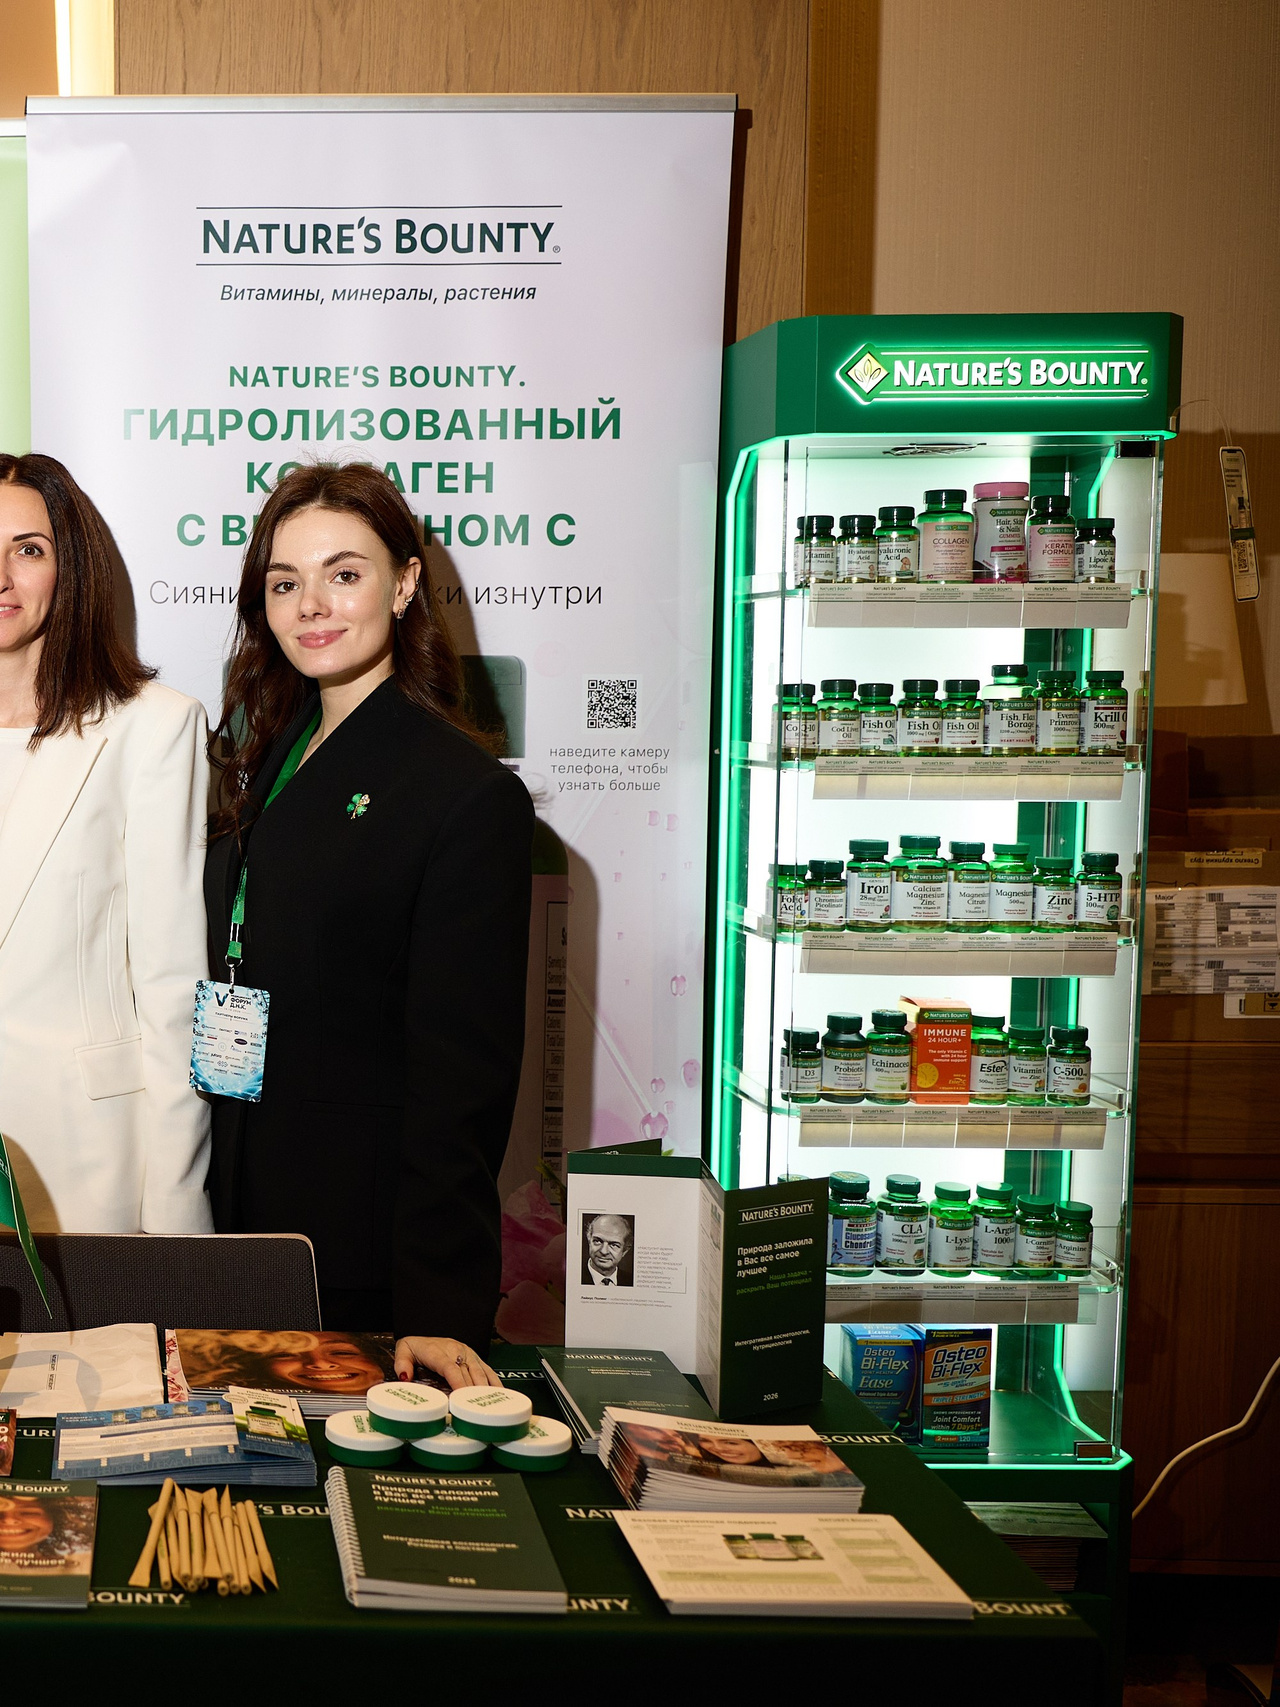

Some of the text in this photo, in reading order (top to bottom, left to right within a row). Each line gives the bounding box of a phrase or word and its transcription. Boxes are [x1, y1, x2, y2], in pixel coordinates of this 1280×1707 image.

[202, 215, 381, 254] NATURE'S
[220, 284, 536, 304] Витамины, минералы, растения
[229, 365, 525, 389] NATURE'S BOUNTY.
[894, 358, 1022, 386] NATURE'S
[123, 396, 621, 445] ГИДРОЛИЗОВАННЫЙ
[247, 461, 494, 494] КАГЕН
[177, 514, 205, 546] С
[222, 514, 529, 547] ВНОМ
[150, 581, 239, 604] Сияни
[476, 586, 602, 609] изнутри
[862, 720, 883, 729] Fish
[1094, 712, 1119, 722] Krill
[908, 721, 929, 730] Fish
[947, 722, 979, 730] Fish Oil
[1008, 721, 1034, 729] Borage
[550, 745, 669, 761] наведите камеру
[551, 762, 668, 777] телефона, чтобы
[558, 778, 659, 793] узнать больше
[860, 882, 889, 894] Iron
[1048, 895, 1072, 905] Zinc
[1086, 892, 1120, 902] 5-HTP
[924, 1029, 967, 1037] IMMUNE
[872, 1059, 909, 1067] Echinacea
[805, 1069, 815, 1077] D3
[742, 1207, 779, 1222] NATURE'S
[901, 1224, 923, 1234] CLA
[737, 1237, 813, 1256] Природа заложила
[744, 1250, 800, 1265] Вас все самое
[737, 1266, 767, 1278] лучшее
[865, 1348, 895, 1357] Osteo
[934, 1346, 987, 1365] Osteo
[861, 1357, 909, 1374] Bi-Flex
[931, 1362, 982, 1380] Bi-Flex
[859, 1376, 893, 1389] Ease
[764, 1393, 779, 1401] 2026
